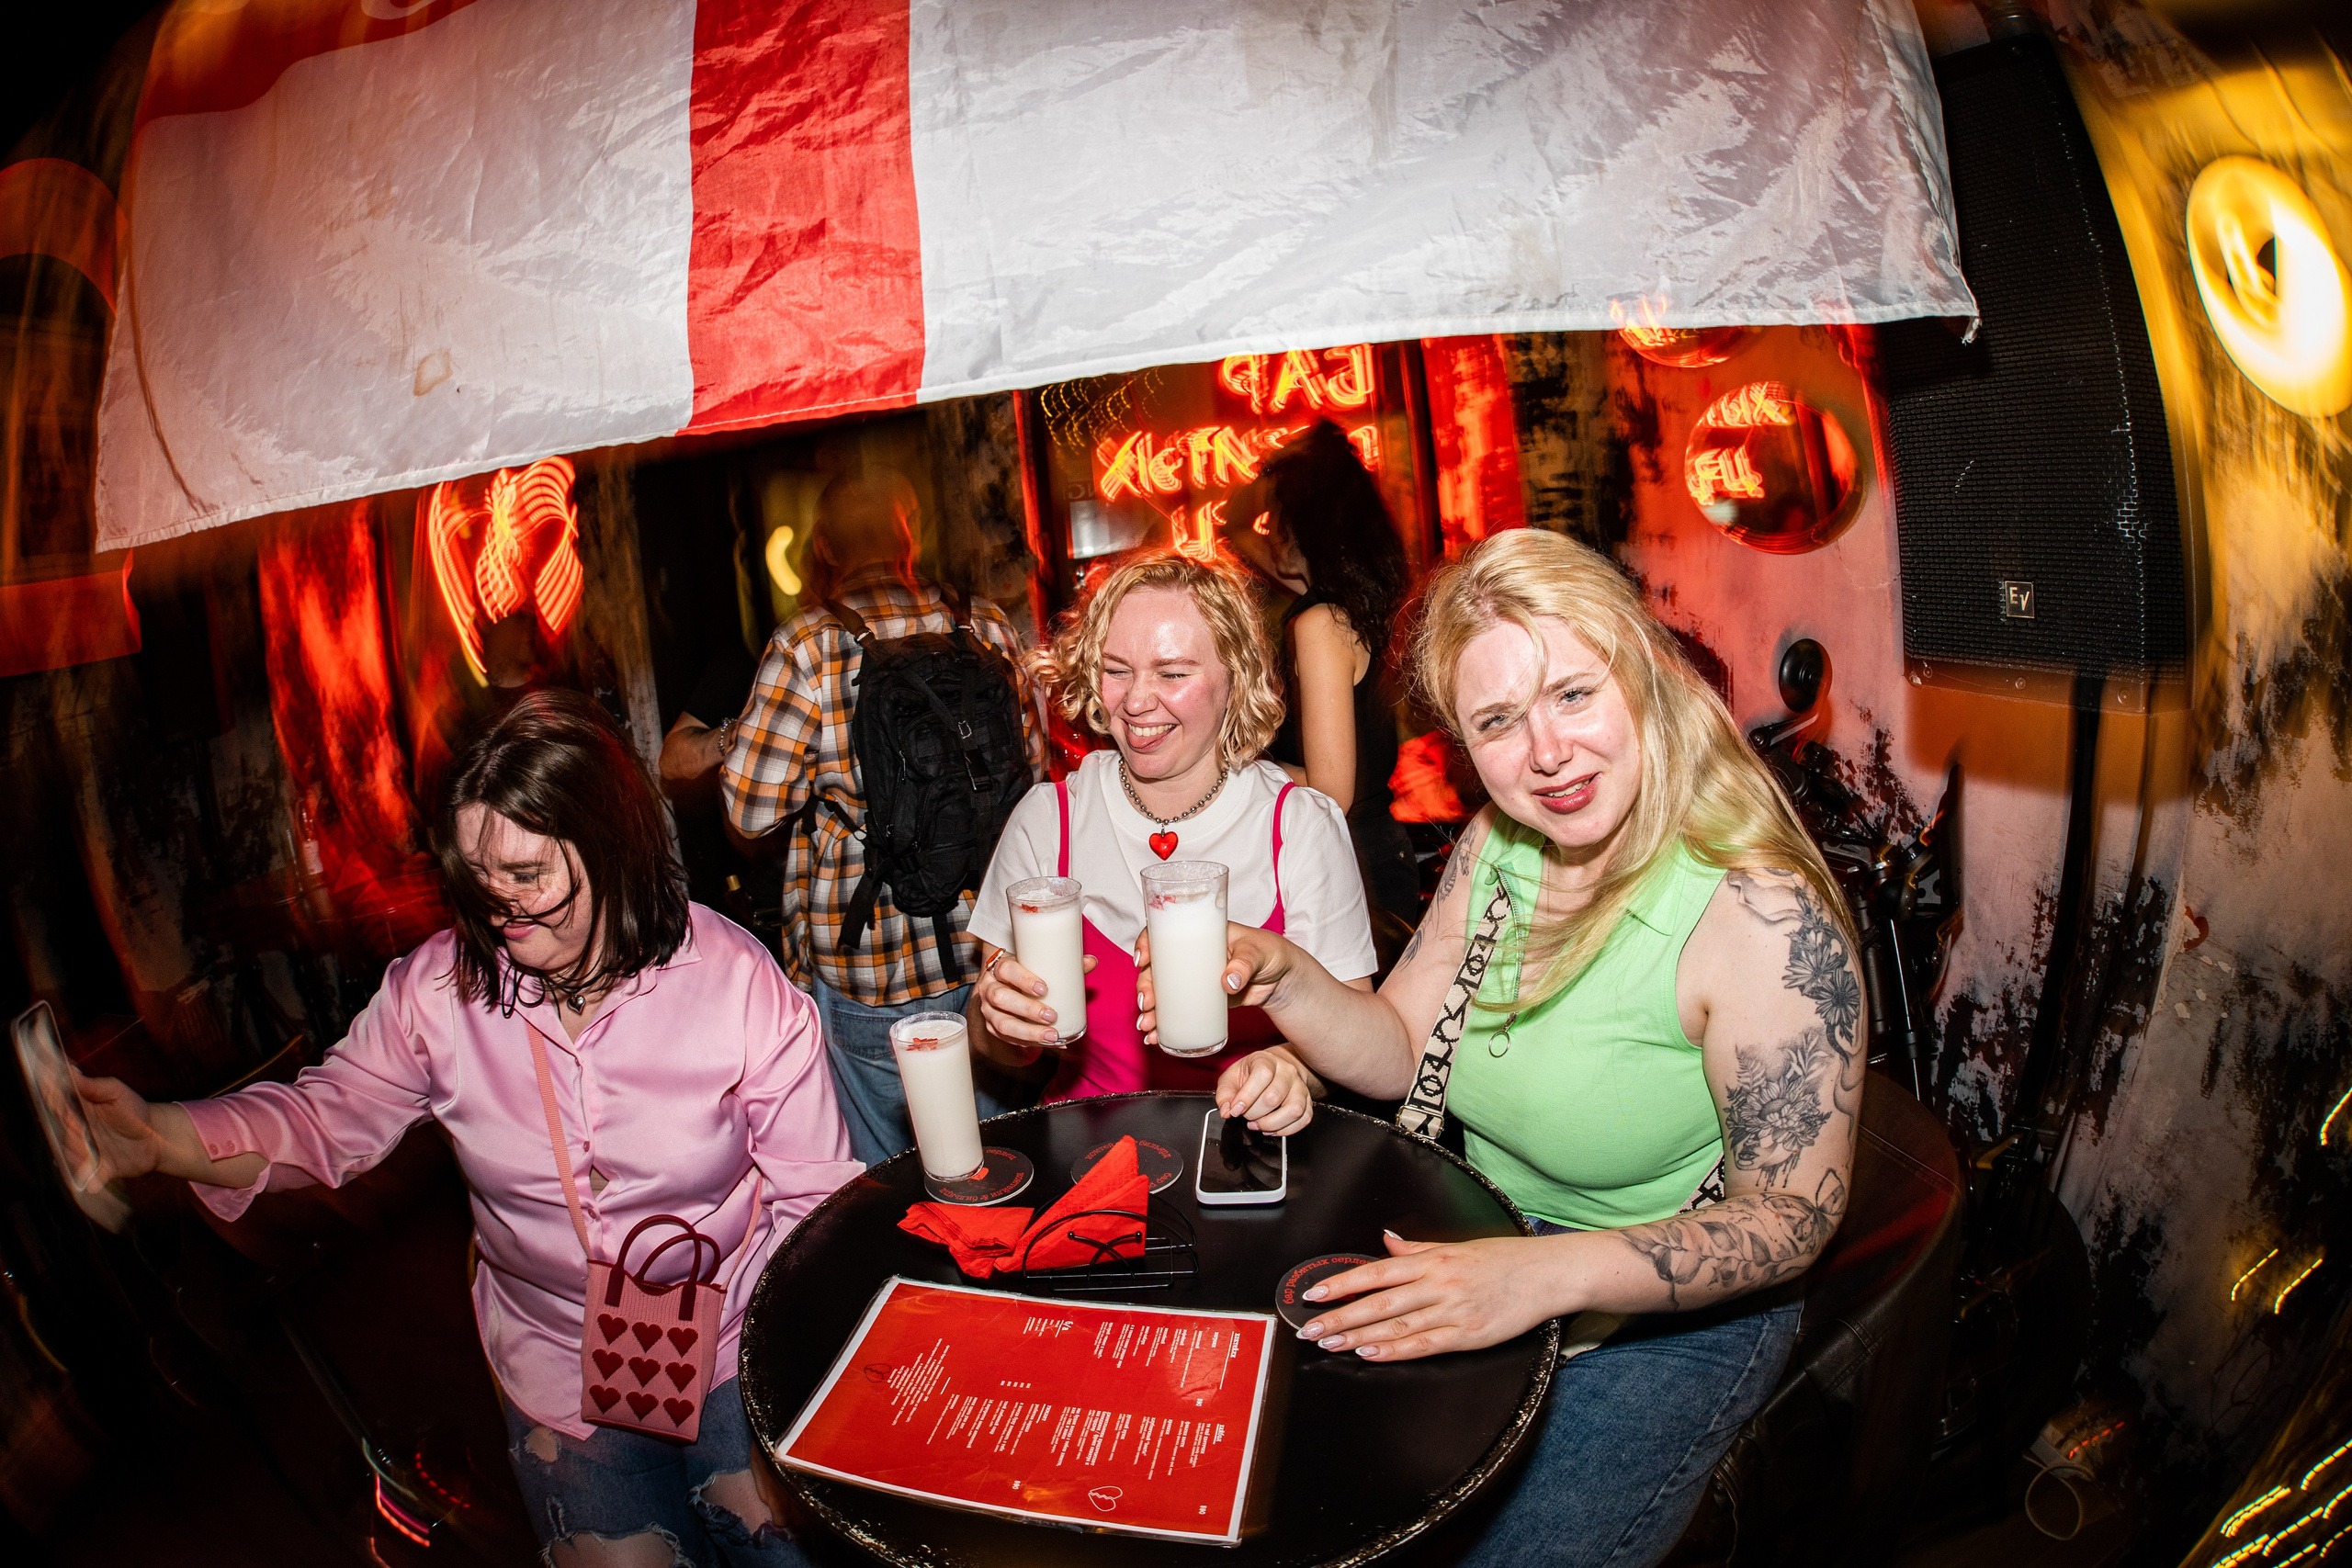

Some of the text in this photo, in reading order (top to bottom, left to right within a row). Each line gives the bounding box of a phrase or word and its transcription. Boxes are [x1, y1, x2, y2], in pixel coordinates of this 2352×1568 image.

[2009, 586, 2030, 611] EV
[1286, 1258, 1329, 1287] разбитых
[1283, 1288, 1295, 1304] бар
